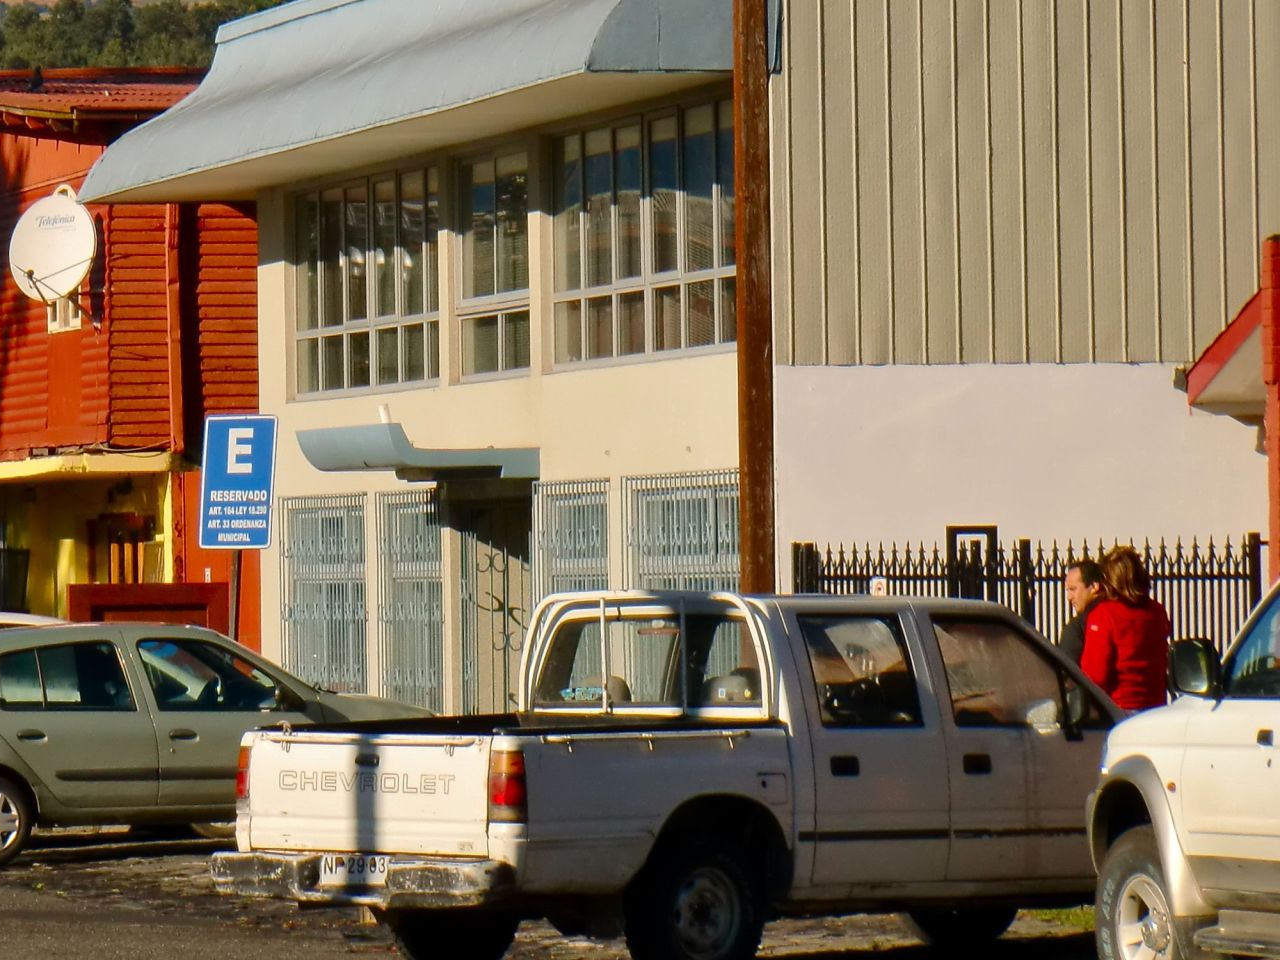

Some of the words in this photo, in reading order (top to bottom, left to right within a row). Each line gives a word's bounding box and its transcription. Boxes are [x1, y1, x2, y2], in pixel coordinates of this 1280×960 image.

[227, 427, 254, 474] E
[210, 489, 268, 502] RESERVADO
[235, 506, 247, 515] LEY
[230, 519, 267, 529] ORDENANZA
[217, 532, 251, 542] MUNICIPAL
[278, 769, 456, 796] CHEVROLET
